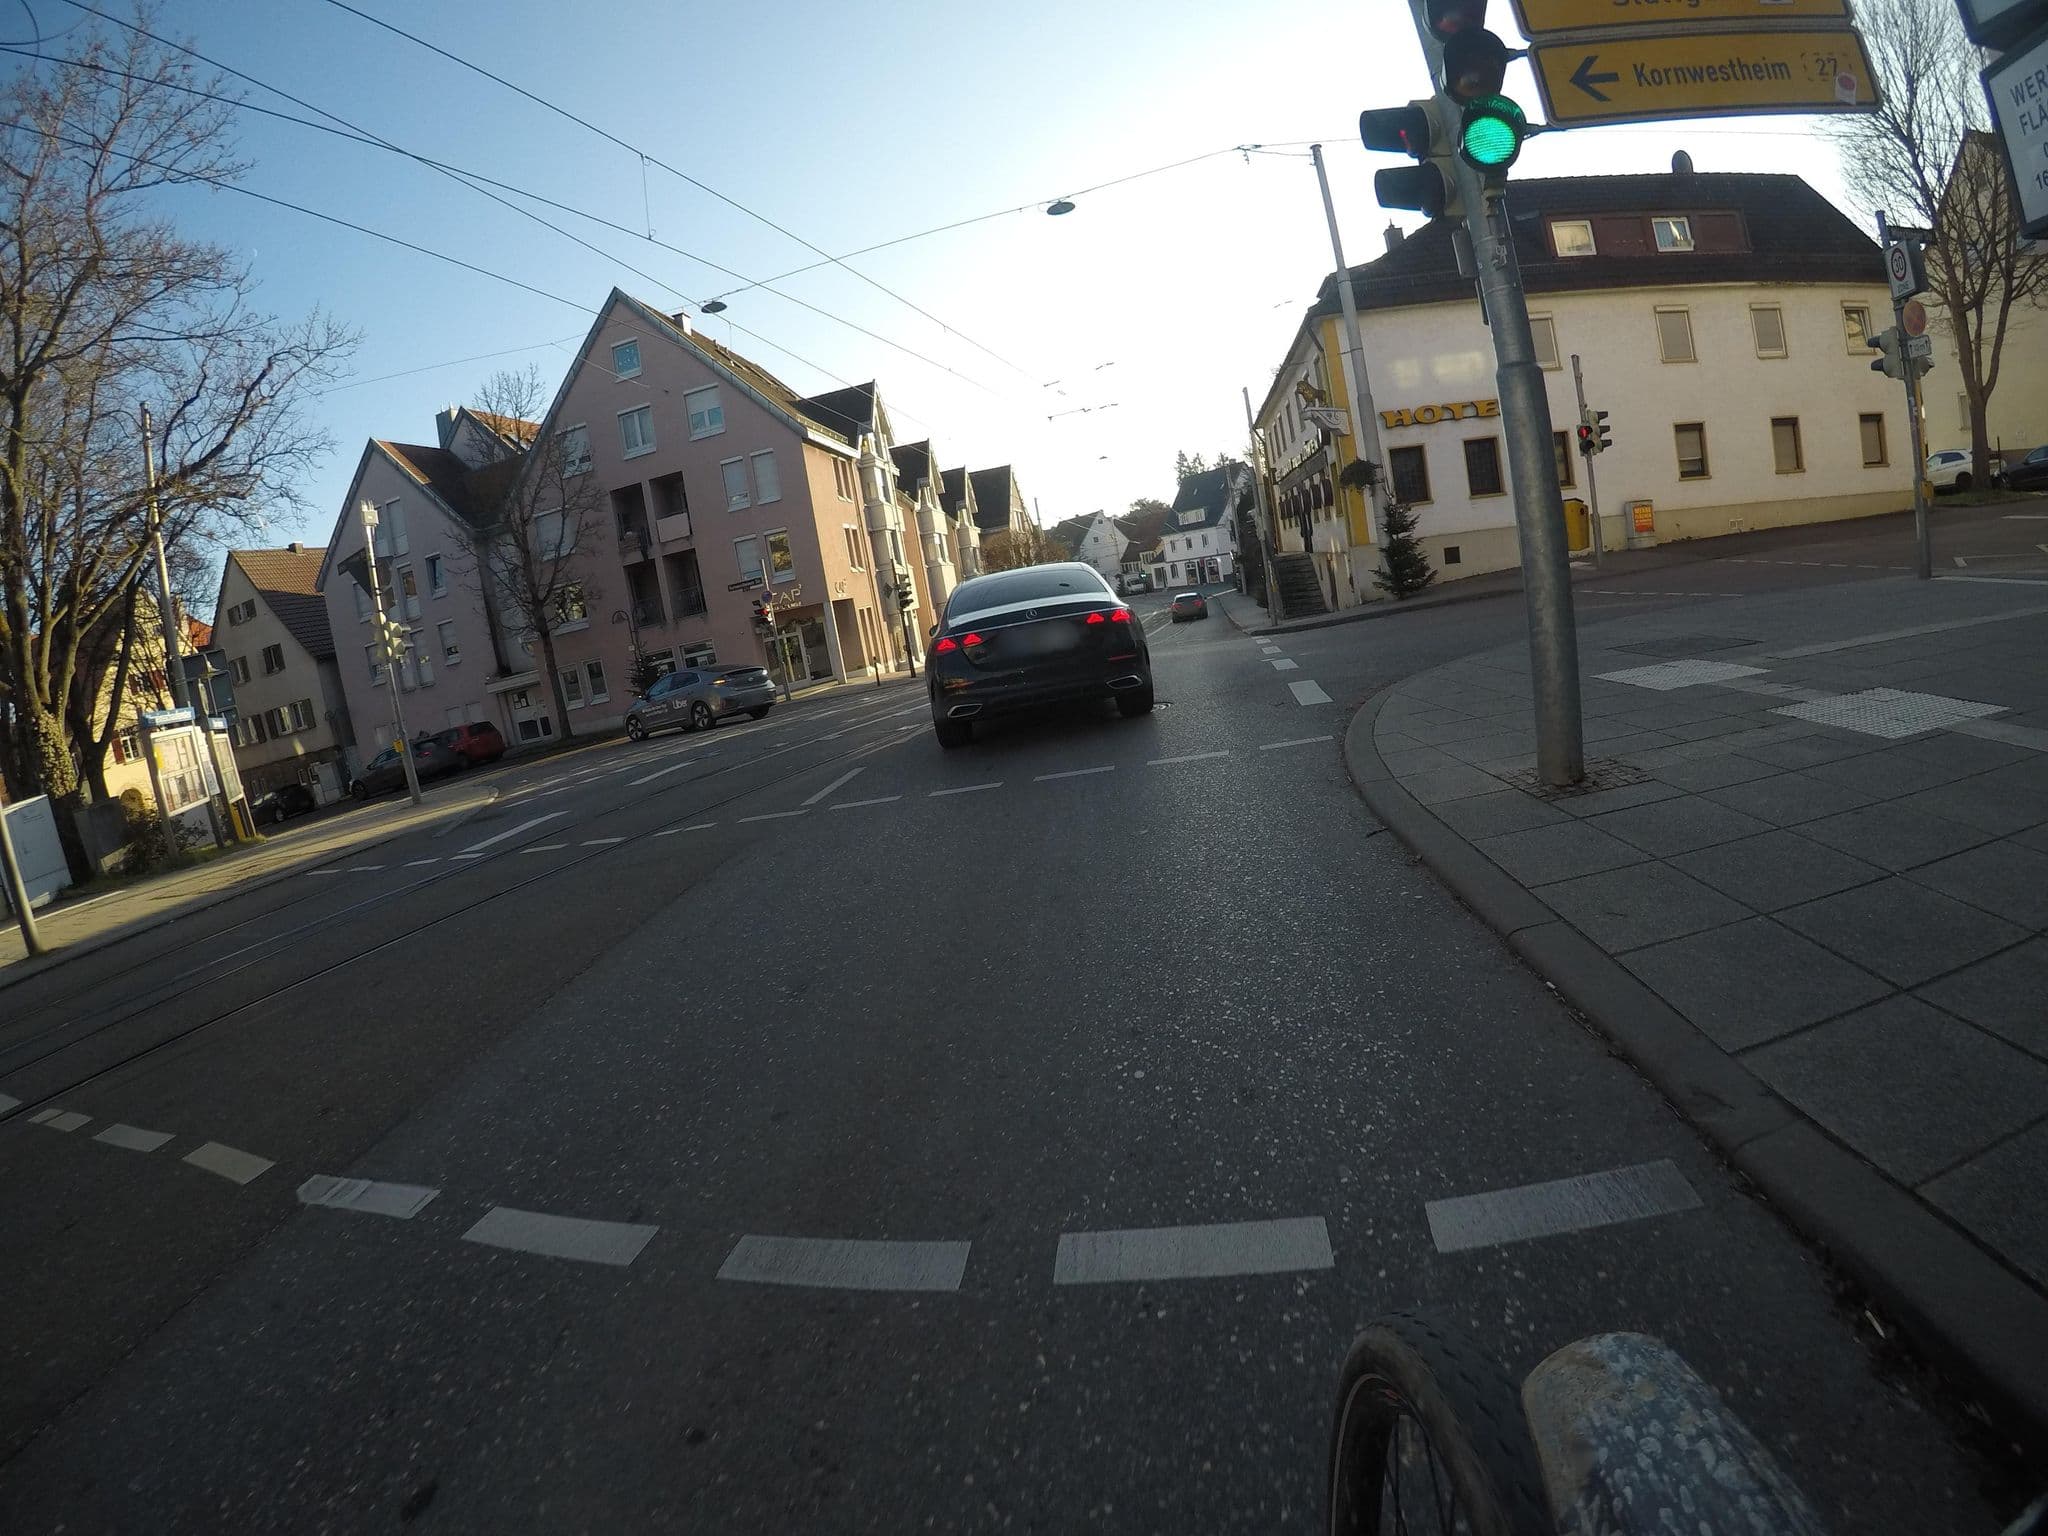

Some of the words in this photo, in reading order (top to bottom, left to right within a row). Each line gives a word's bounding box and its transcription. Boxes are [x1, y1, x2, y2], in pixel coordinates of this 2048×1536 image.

[1632, 57, 1791, 87] Kornwestheim
[1815, 57, 1838, 77] 27
[2010, 65, 2048, 107] WER
[2019, 97, 2048, 136] FLÄ
[1894, 256, 1904, 273] 30
[1380, 399, 1500, 429] HOTE
[672, 699, 688, 710] Uber
